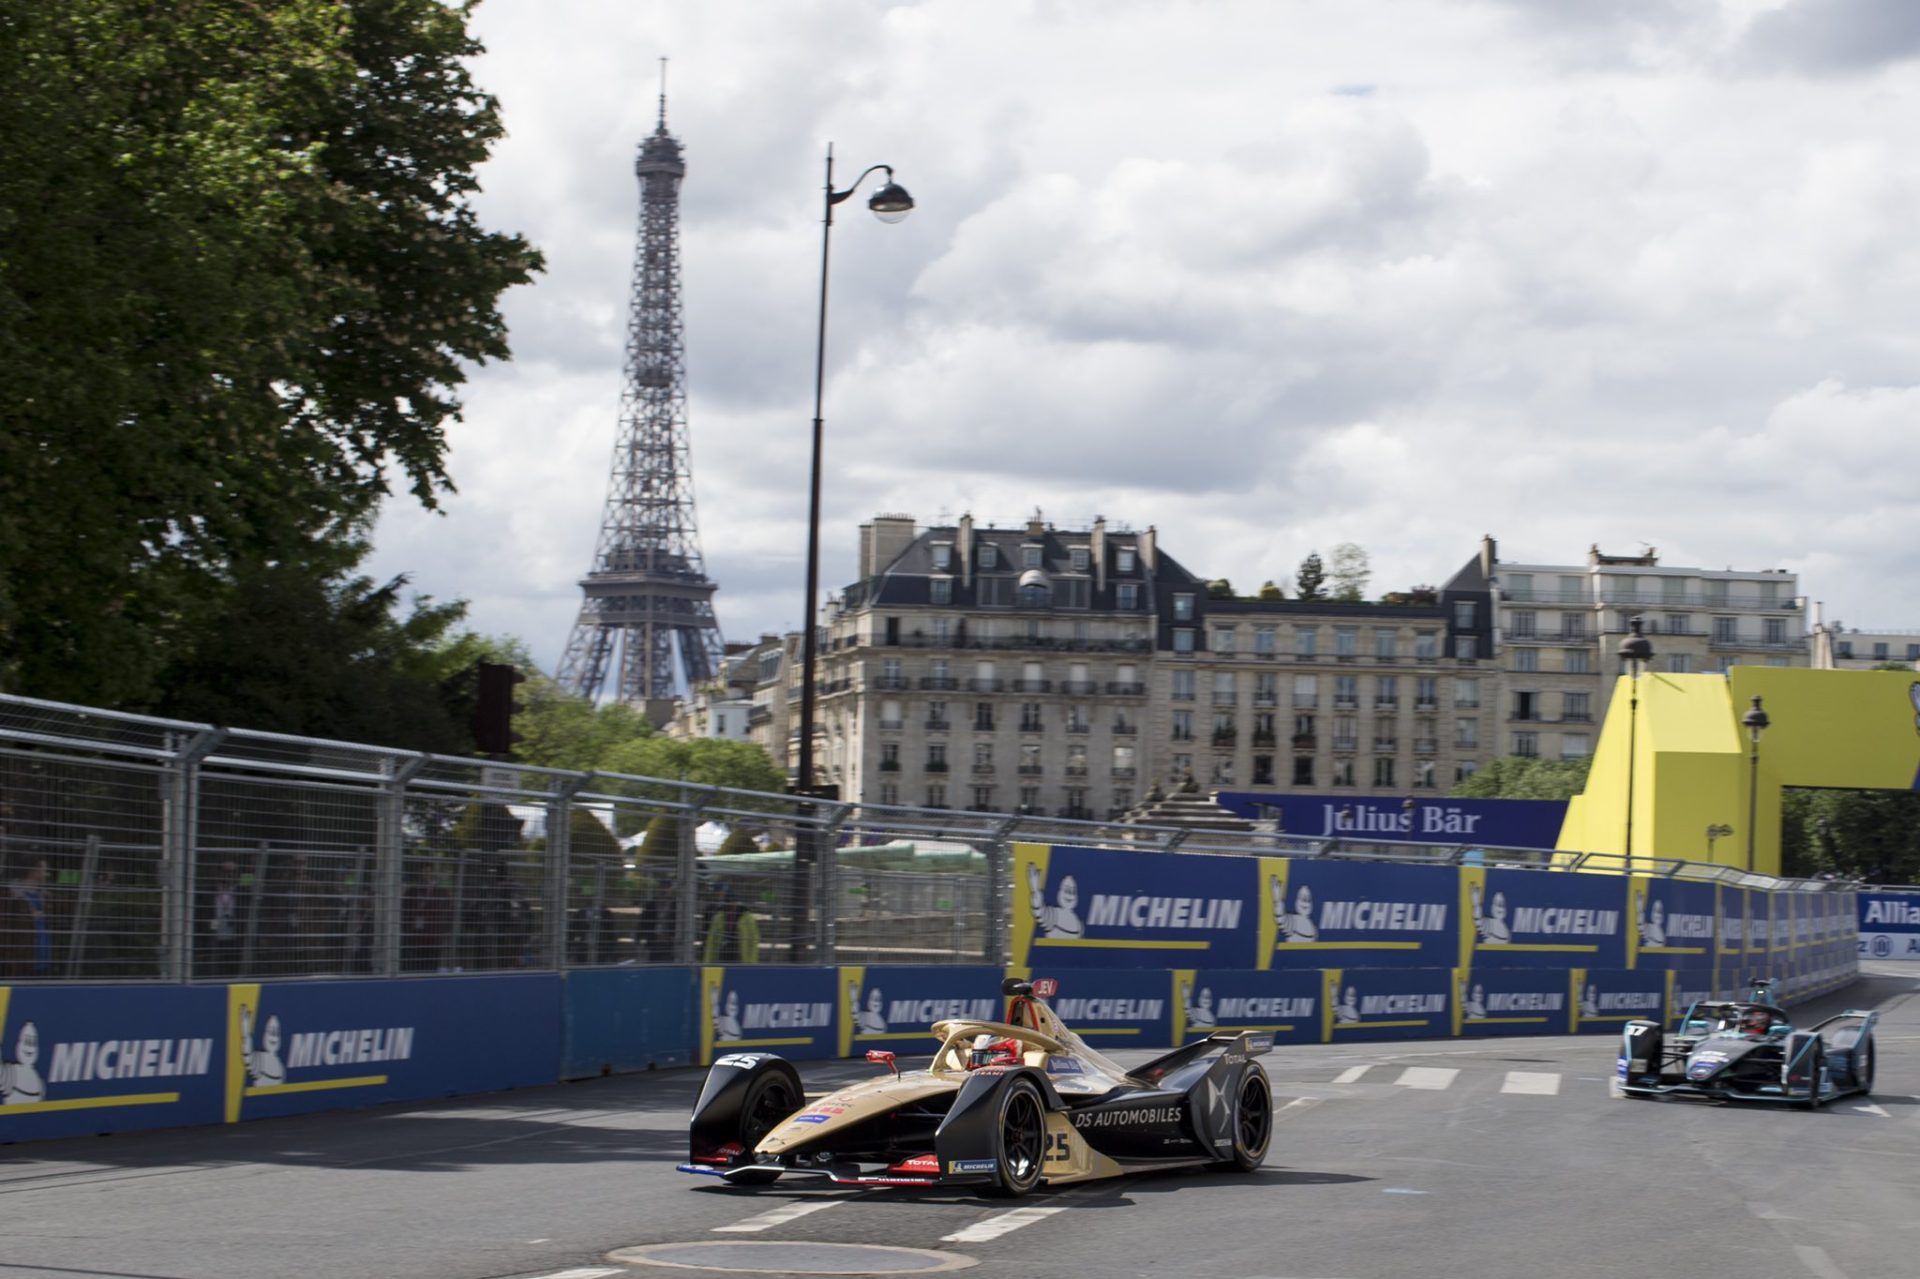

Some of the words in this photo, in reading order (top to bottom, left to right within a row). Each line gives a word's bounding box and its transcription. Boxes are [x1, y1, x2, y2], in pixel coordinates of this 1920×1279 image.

[1322, 804, 1413, 836] Julius
[1422, 806, 1481, 833] Bär
[1087, 894, 1243, 930] MICHELIN
[1319, 901, 1447, 931] MICHELIN
[1512, 907, 1619, 936] MICHELIN
[1038, 980, 1053, 994] JEV
[1056, 998, 1164, 1021] MICHELIN
[1217, 997, 1315, 1019] MICHELIN
[1360, 994, 1446, 1015] MICHELIN
[1486, 992, 1564, 1012] MICHELIN
[1598, 991, 1662, 1009] MICHELIN
[742, 1002, 832, 1029] MICHELIN
[887, 999, 995, 1025] MICHELIN
[287, 1027, 415, 1068] MICHELIN
[1223, 1053, 1247, 1065] TOTAL
[48, 1038, 214, 1084] MICHELIN
[715, 1054, 761, 1070] 25
[1076, 1113, 1092, 1128] DS
[1095, 1107, 1182, 1127] AUTOMOBILES
